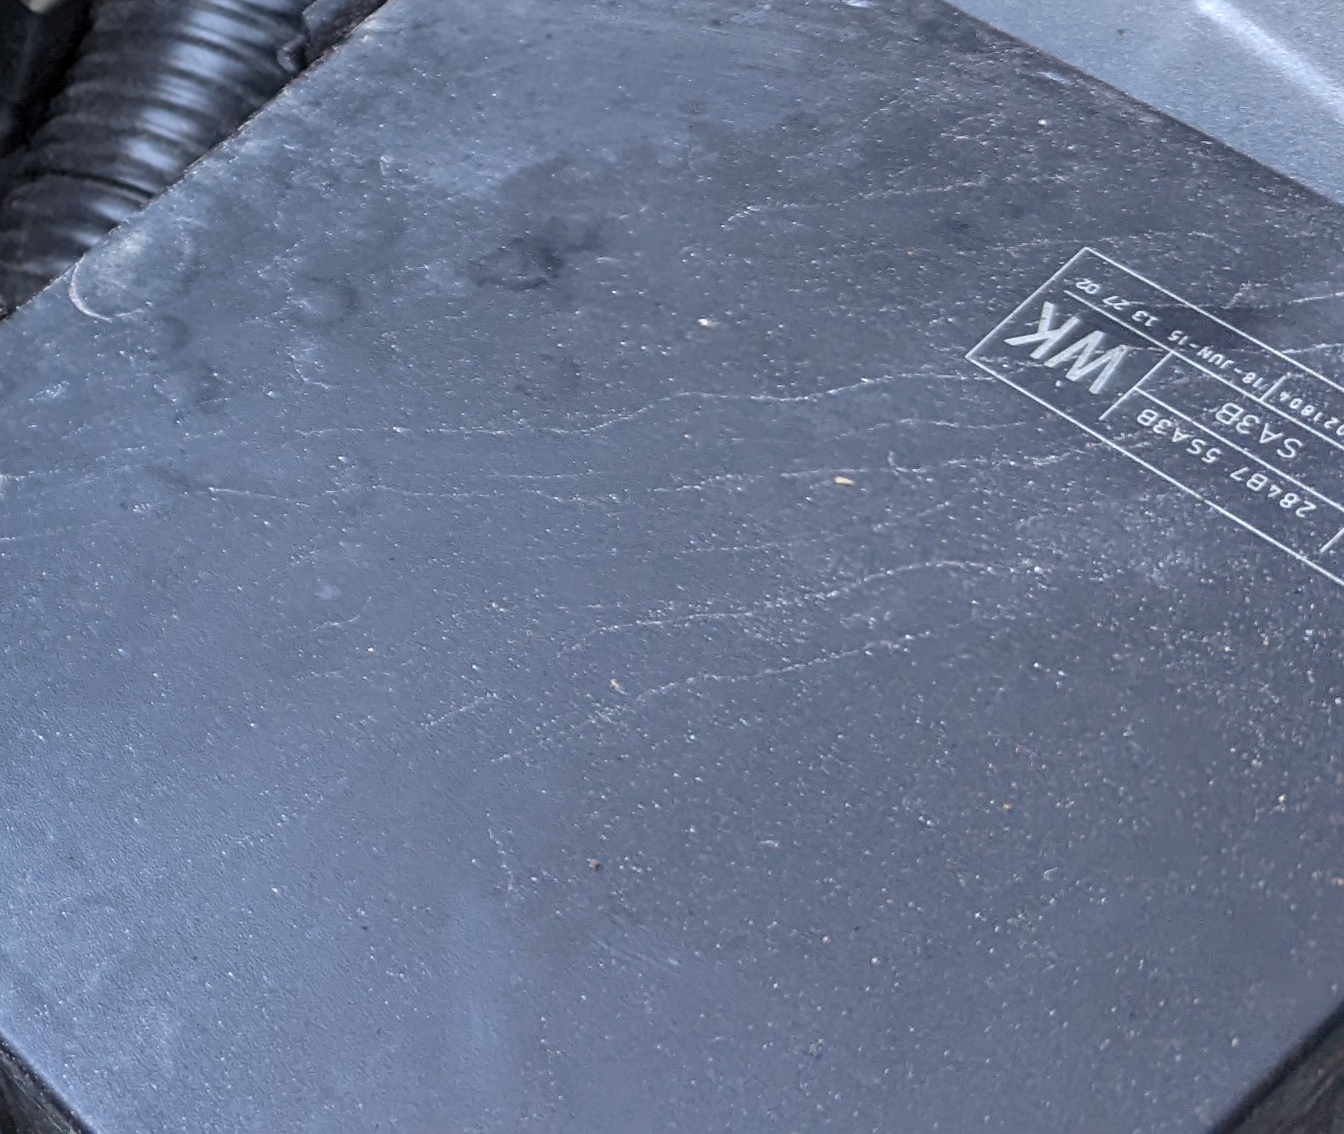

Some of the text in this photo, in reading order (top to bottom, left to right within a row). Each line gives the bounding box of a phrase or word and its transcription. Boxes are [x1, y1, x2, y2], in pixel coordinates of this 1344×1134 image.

[1004, 300, 1130, 395] WK
[1168, 329, 1264, 388] 18-JUN-15
[1137, 408, 1317, 519] 284B7 5SA3B
[1215, 402, 1304, 459] SA3B
